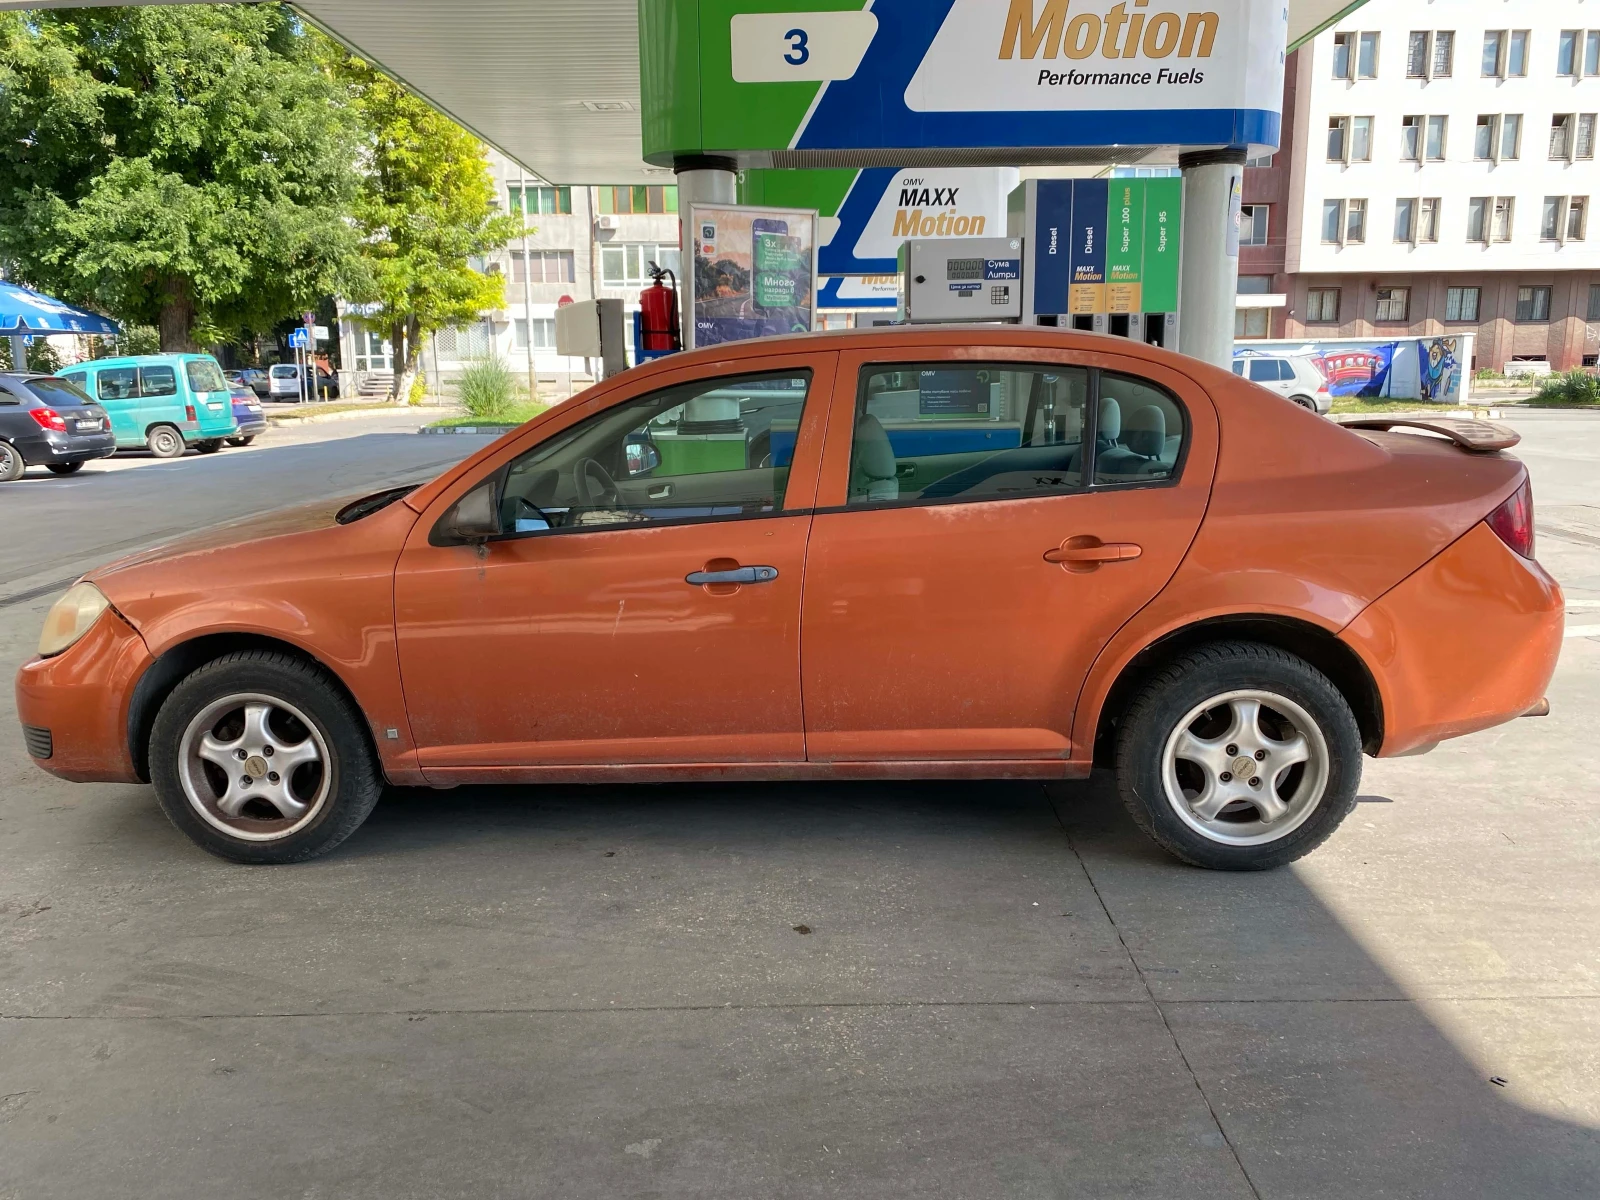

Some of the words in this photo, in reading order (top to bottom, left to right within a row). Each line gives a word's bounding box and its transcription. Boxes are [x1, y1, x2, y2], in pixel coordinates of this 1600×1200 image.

[998, 0, 1220, 60] Motion
[782, 28, 810, 66] 3
[1037, 69, 1152, 86] Performance
[1156, 67, 1205, 85] Fuels
[899, 188, 960, 206] MAXX
[1124, 187, 1132, 206] plus
[892, 209, 986, 236] Motion
[1122, 207, 1130, 224] 100
[1159, 210, 1167, 223] 95
[1049, 227, 1058, 255] Diesel
[1085, 226, 1094, 254] Diesel
[1121, 226, 1131, 253] Super
[1158, 226, 1167, 252] Super
[987, 260, 1010, 269] Сума
[764, 276, 795, 287] Много
[987, 271, 1016, 280] Литри
[1074, 271, 1102, 280] Motion
[1110, 271, 1138, 280] Motion
[764, 287, 789, 295] награди
